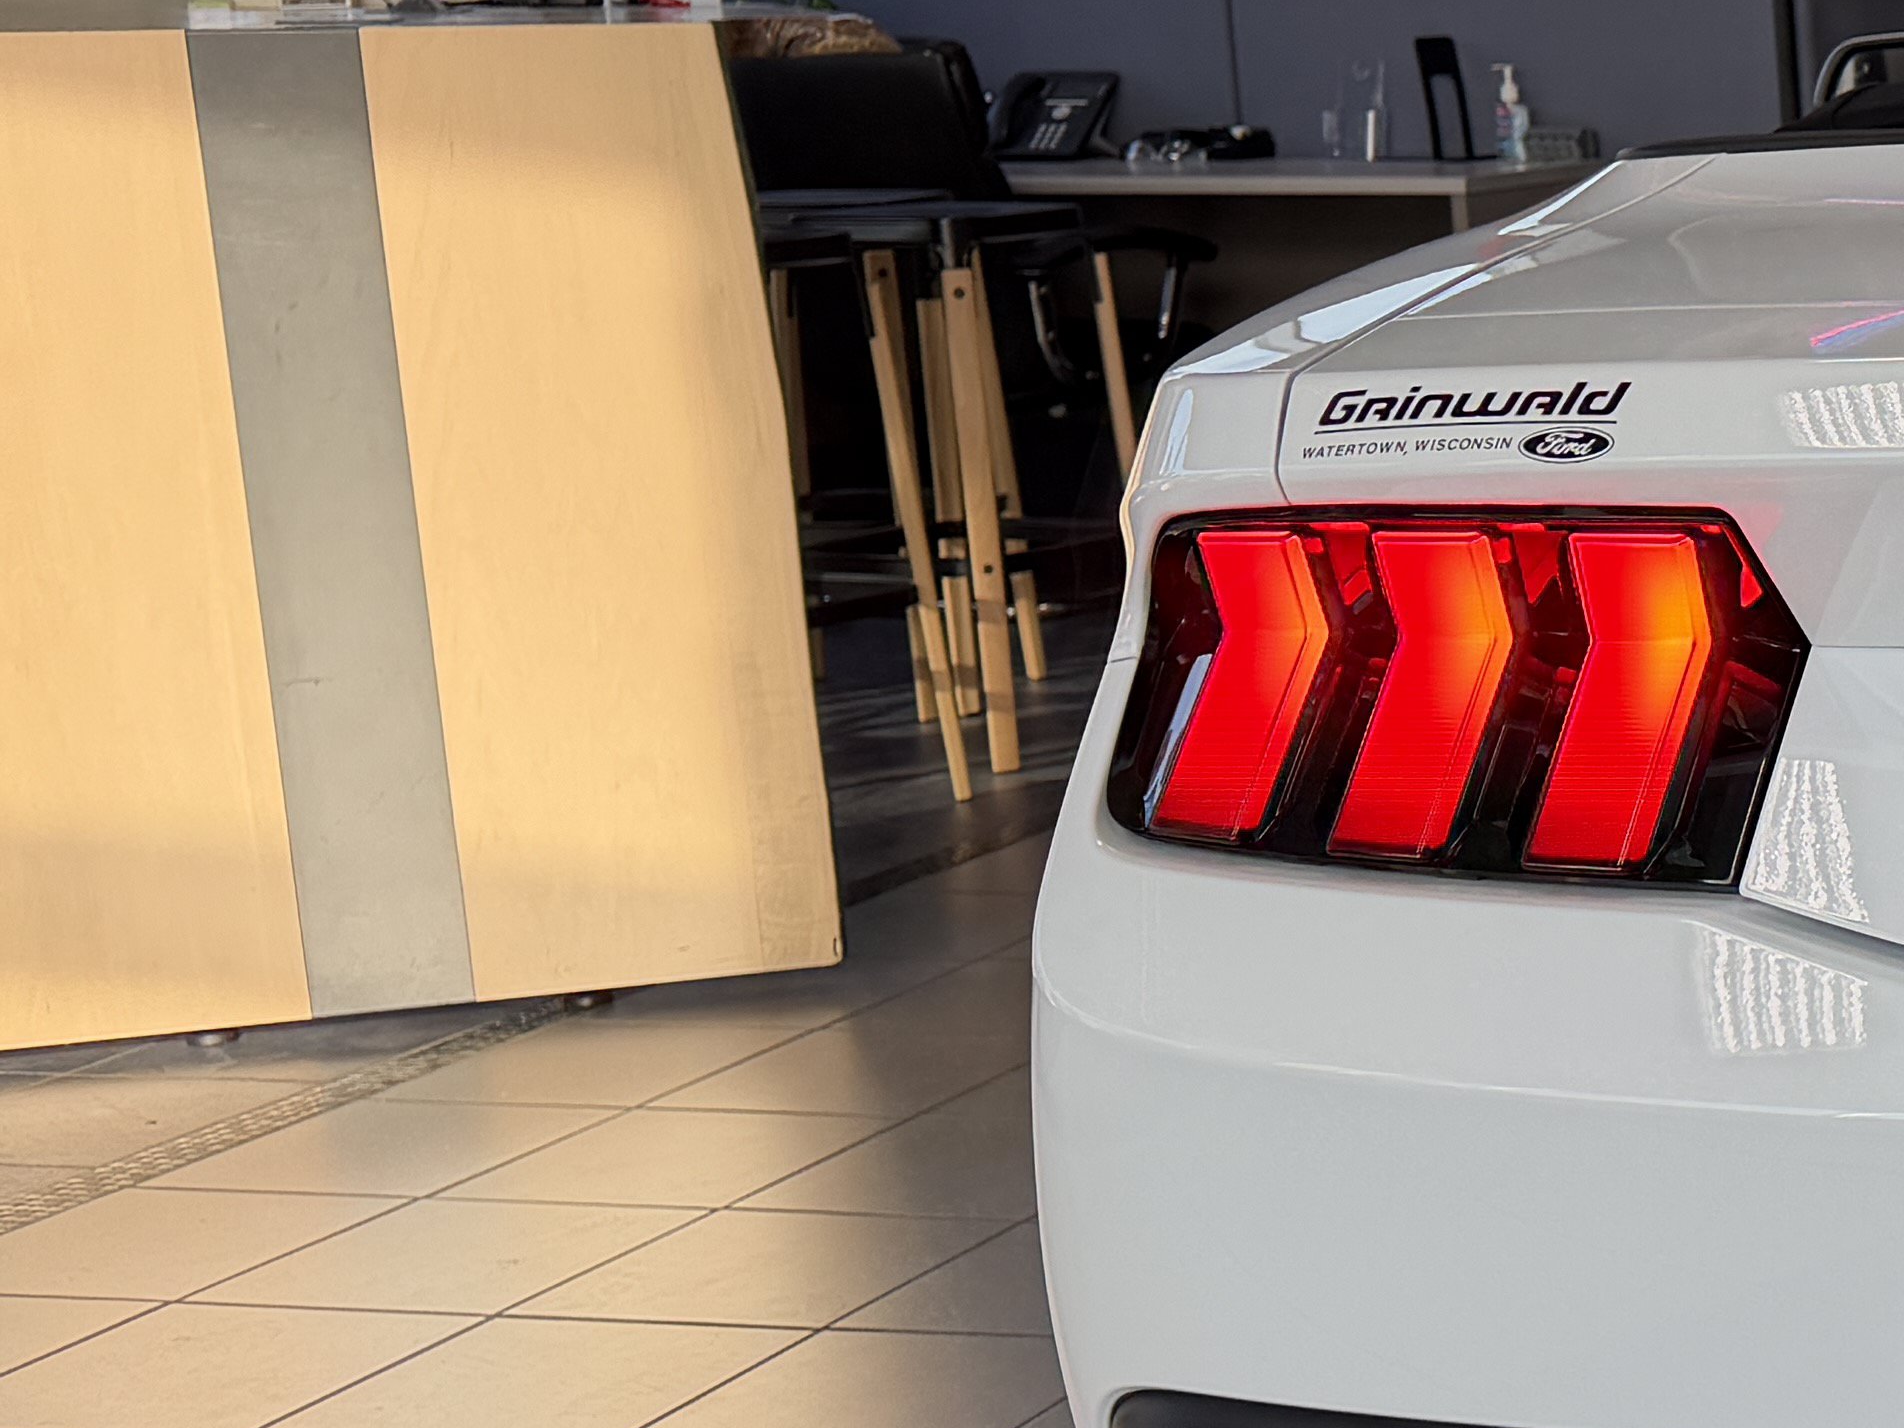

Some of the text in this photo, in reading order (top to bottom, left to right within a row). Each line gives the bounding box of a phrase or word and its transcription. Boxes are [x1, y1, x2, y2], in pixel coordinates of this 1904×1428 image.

[1302, 436, 1513, 460] WATERTOWN, WISCONSIN
[1535, 432, 1597, 457] Ford
